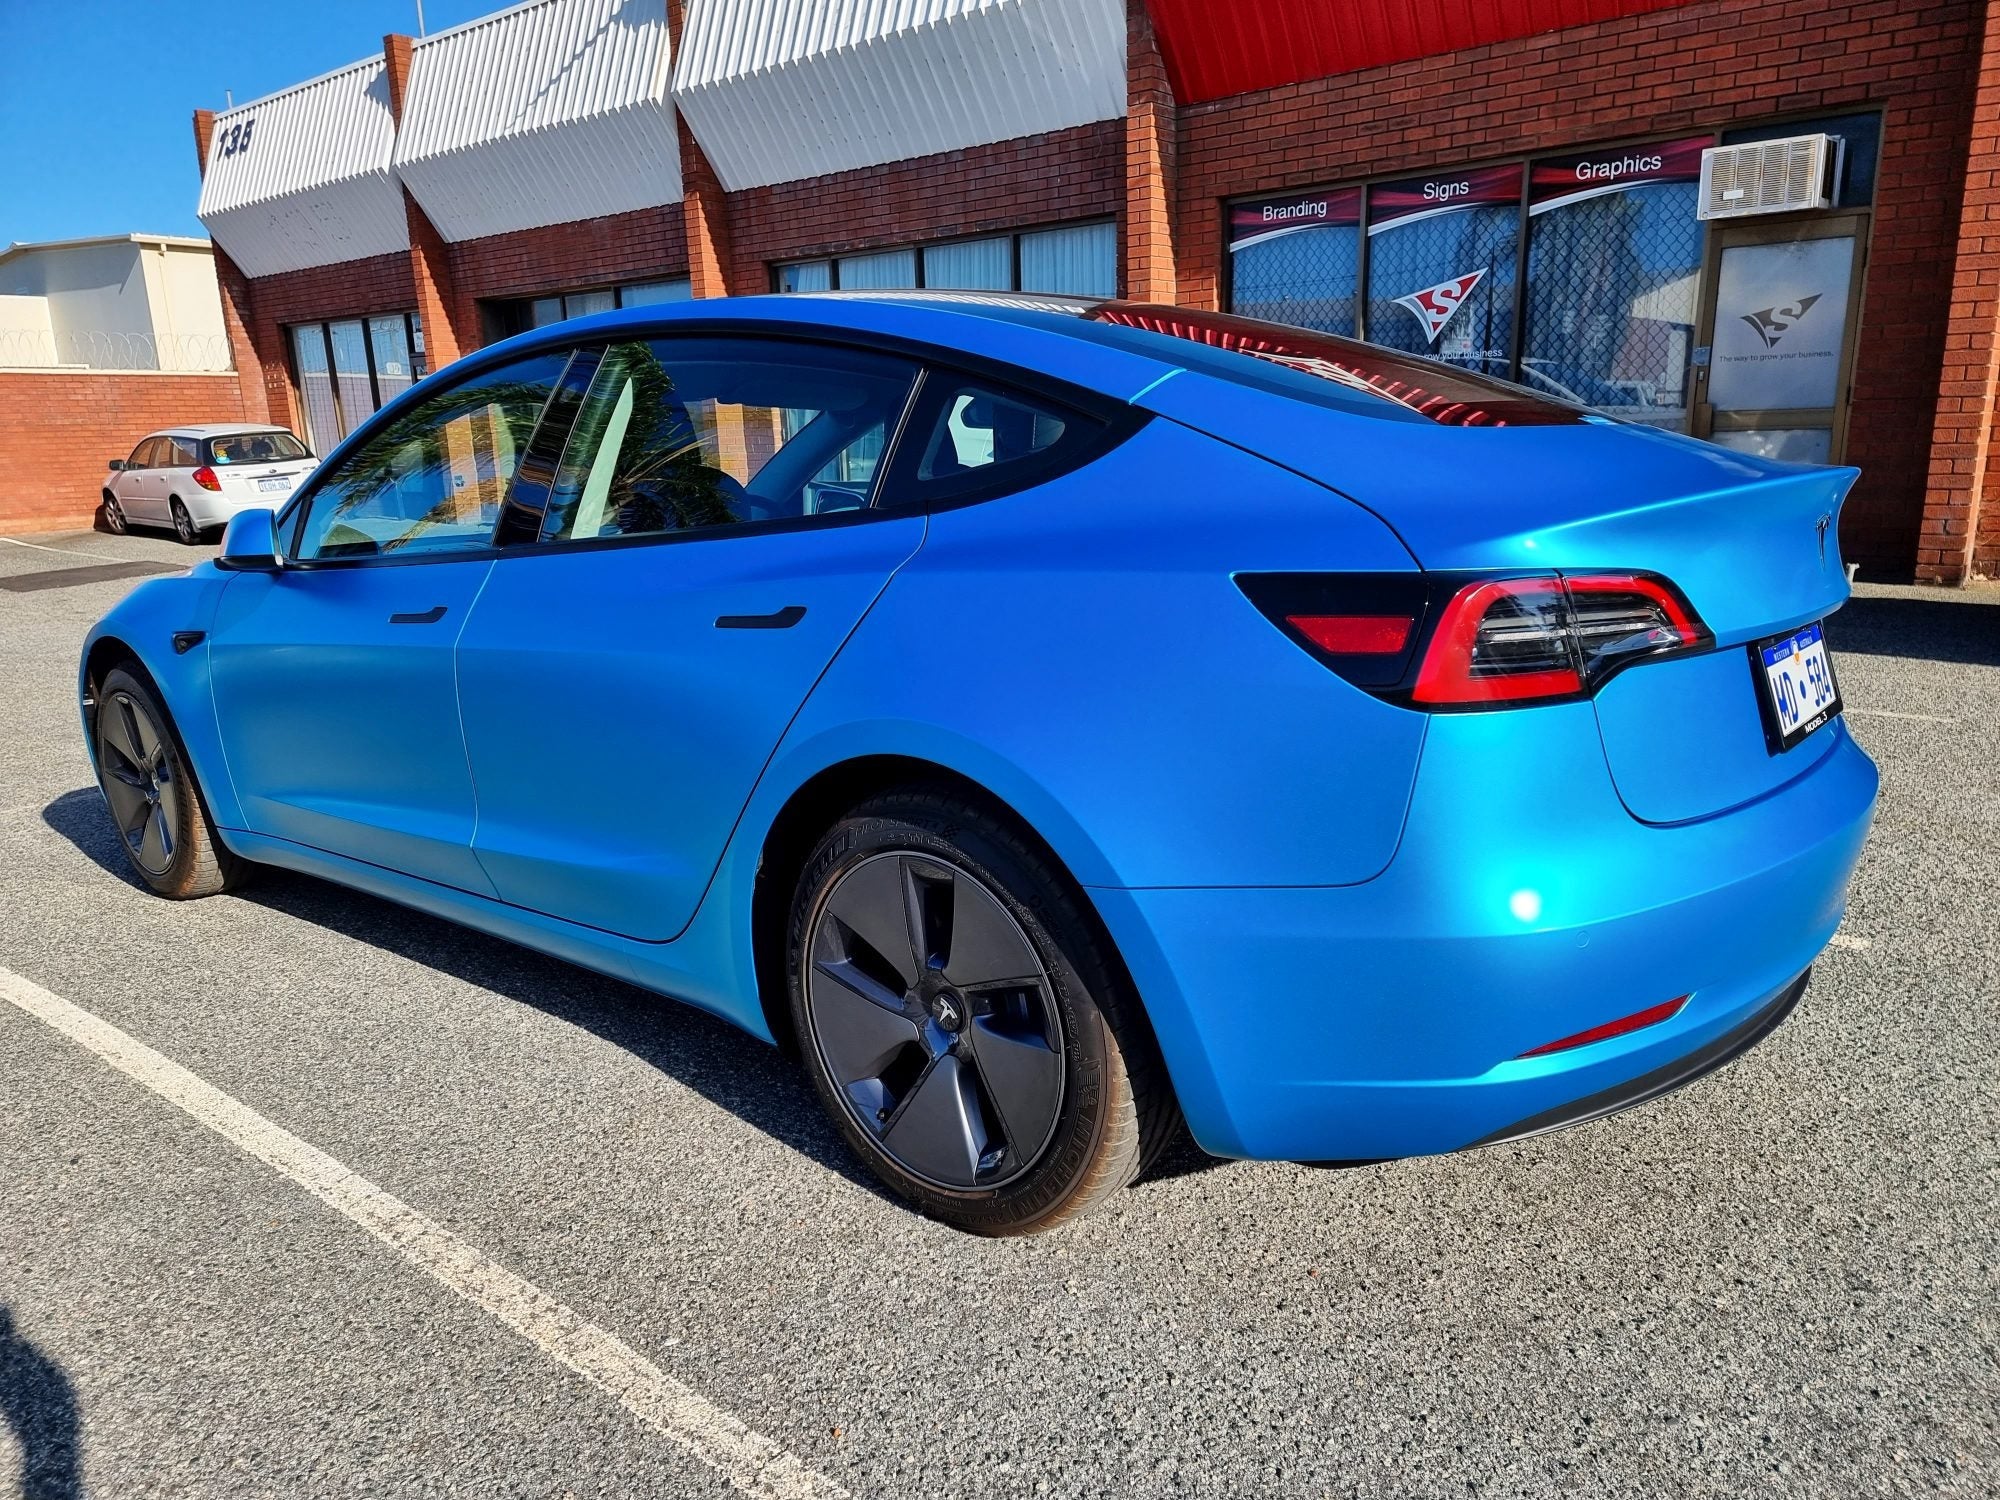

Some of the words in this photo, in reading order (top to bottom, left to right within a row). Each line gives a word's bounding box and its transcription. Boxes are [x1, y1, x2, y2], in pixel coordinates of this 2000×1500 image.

[216, 118, 256, 162] 135
[1575, 154, 1662, 180] Graphics
[1423, 181, 1470, 202] Signs
[1262, 201, 1328, 222] Branding
[1441, 351, 1462, 362] your
[1463, 348, 1503, 359] business
[1720, 355, 1733, 363] The
[1750, 353, 1759, 361] to
[1759, 354, 1778, 362] grow
[1779, 352, 1797, 361] your
[1804, 714, 1823, 733] MODEL
